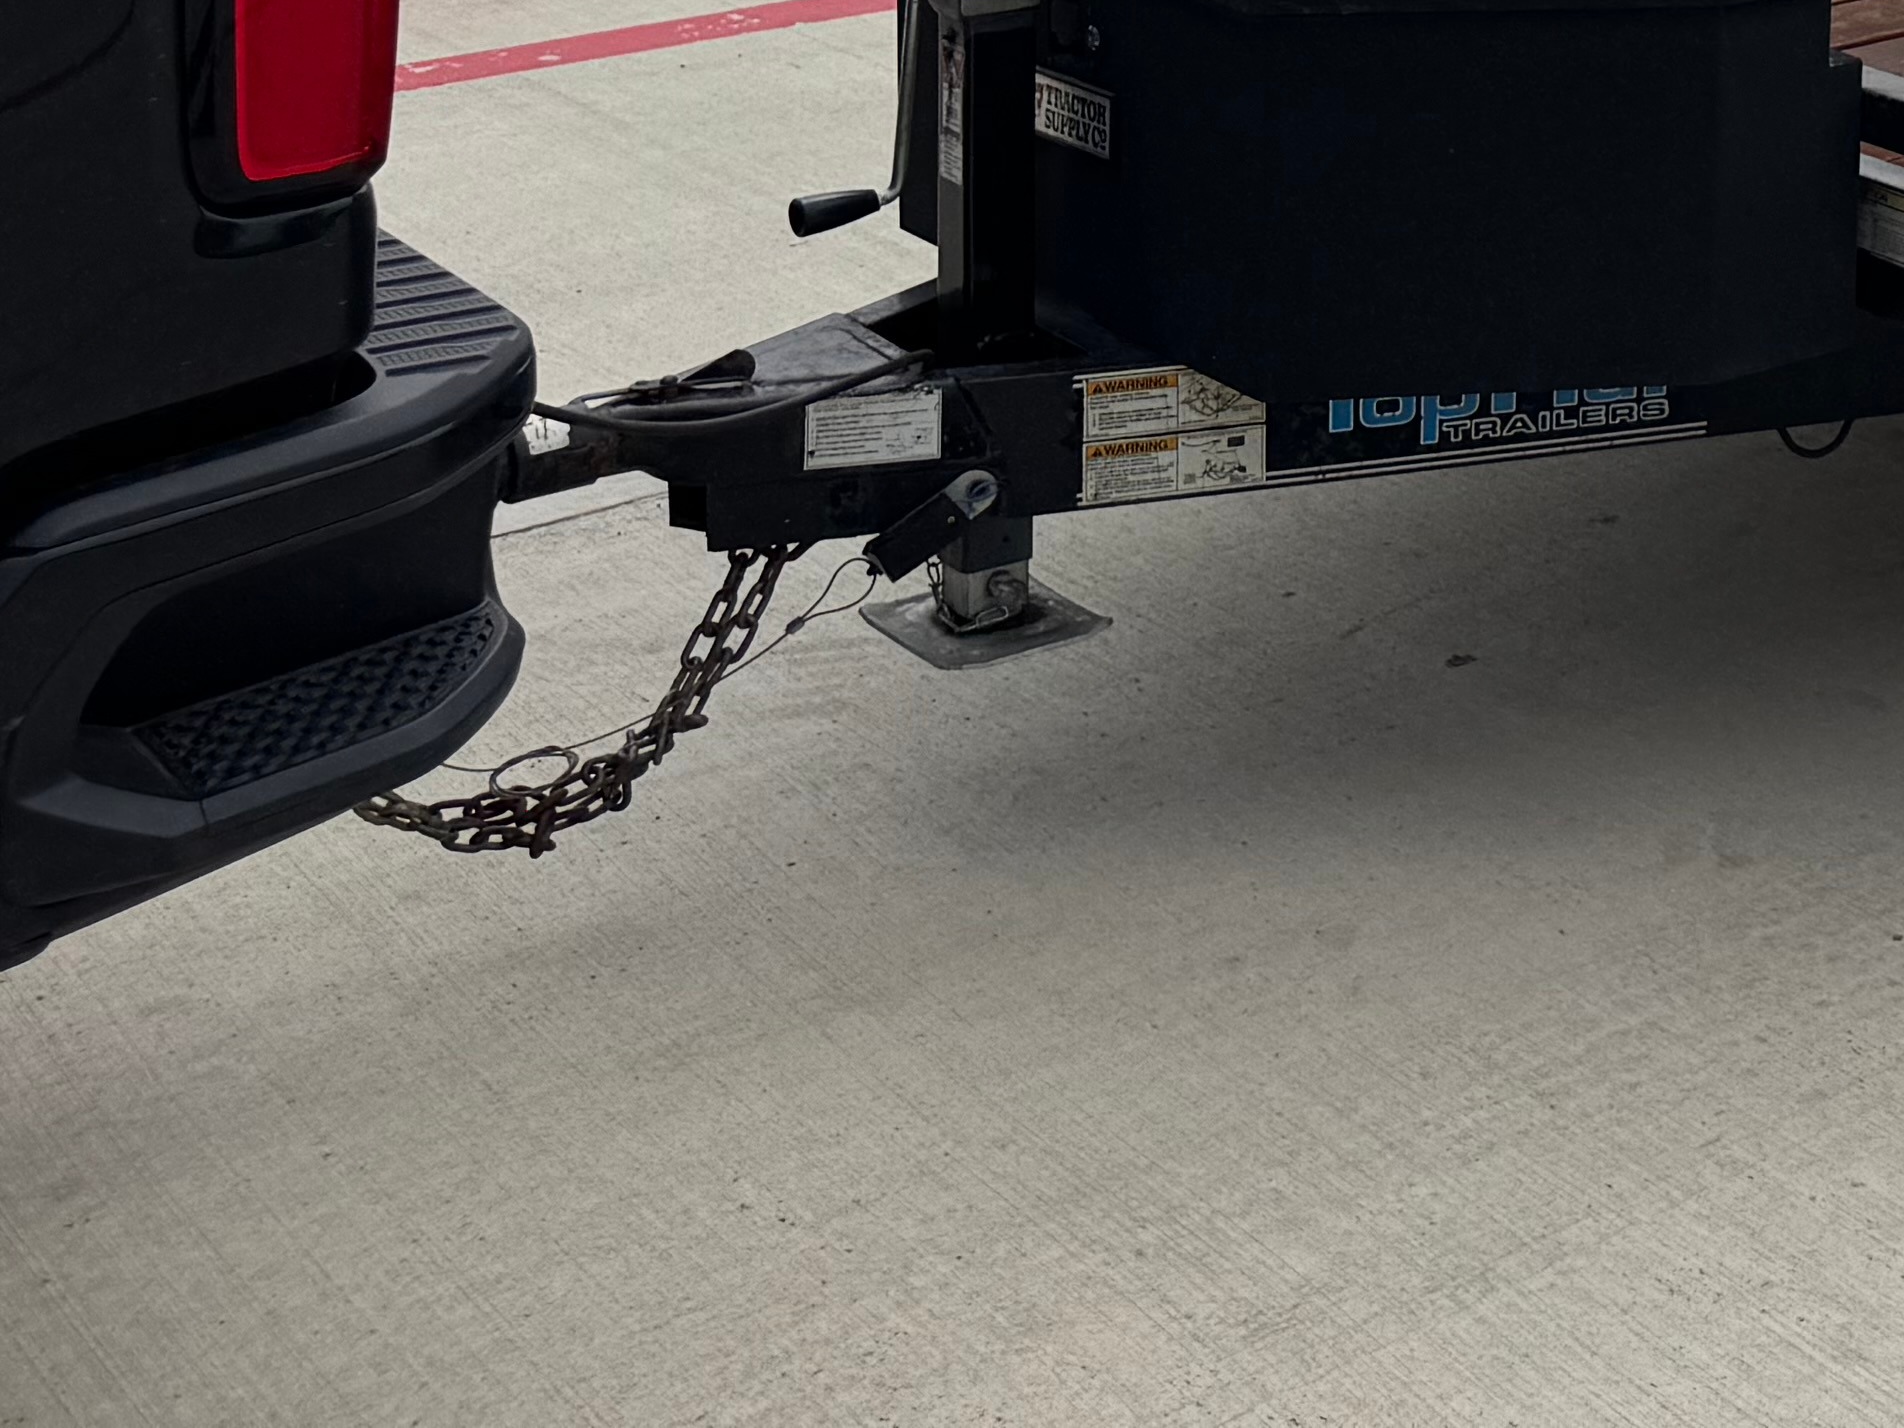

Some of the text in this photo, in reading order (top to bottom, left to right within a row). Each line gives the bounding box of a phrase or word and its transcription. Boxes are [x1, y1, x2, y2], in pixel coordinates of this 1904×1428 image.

[1045, 83, 1107, 127] TRACTOR
[1044, 109, 1092, 145] SUPPLY
[1104, 374, 1169, 393] WARNING
[1441, 398, 1670, 442] TRAILERS
[1104, 439, 1169, 457] WARNING
